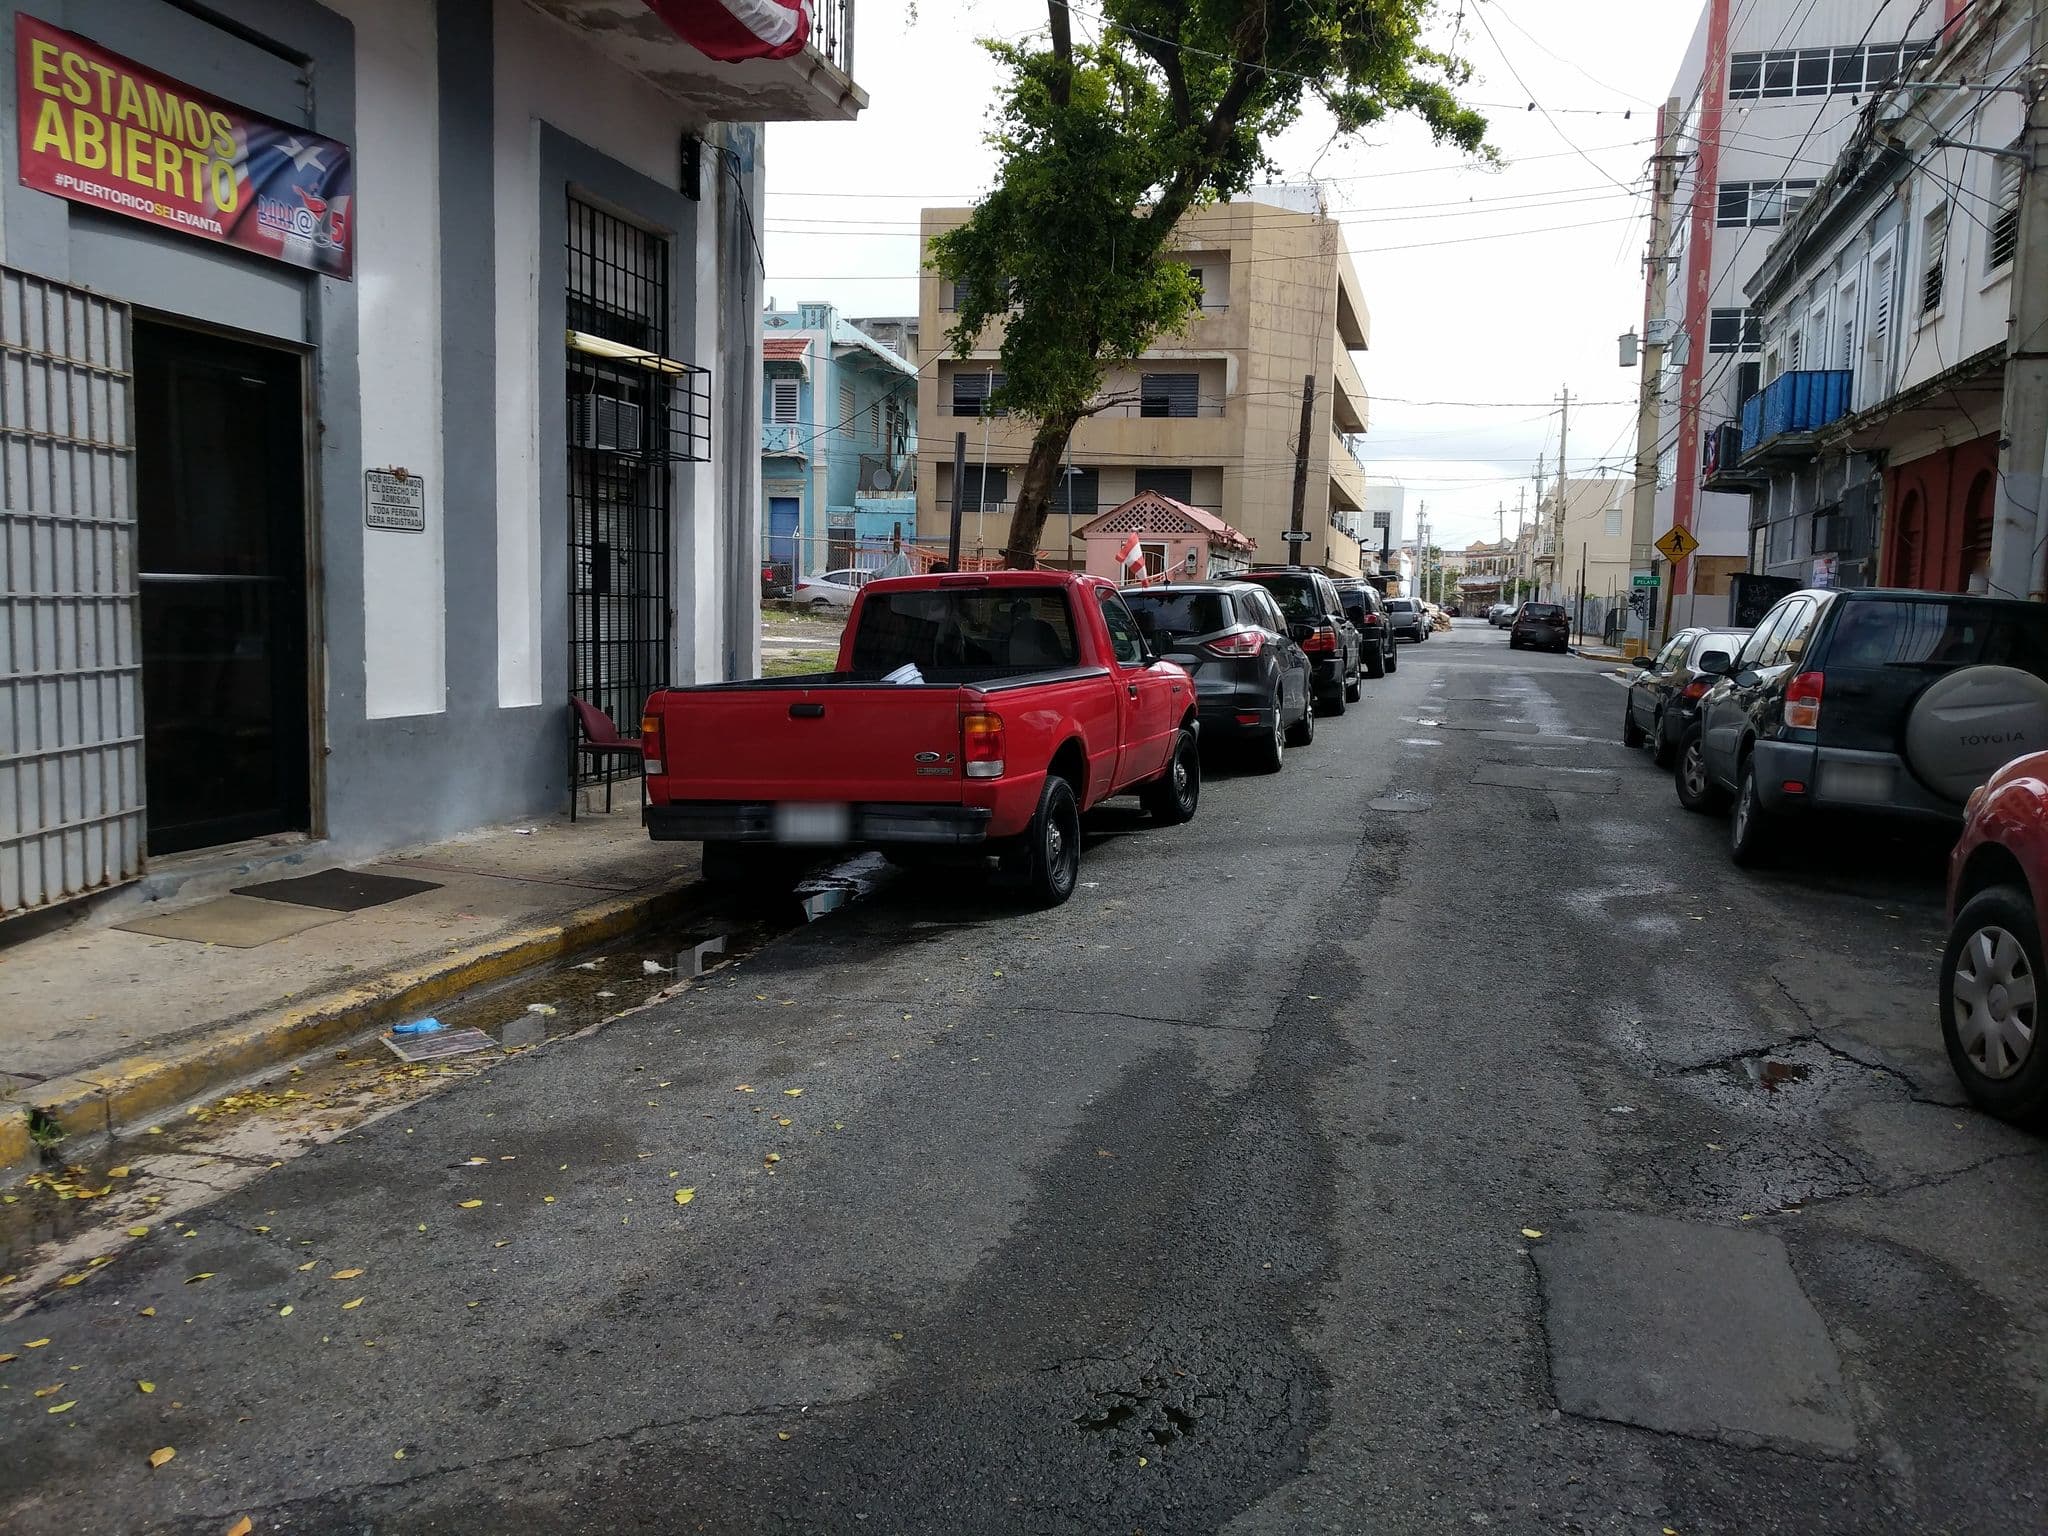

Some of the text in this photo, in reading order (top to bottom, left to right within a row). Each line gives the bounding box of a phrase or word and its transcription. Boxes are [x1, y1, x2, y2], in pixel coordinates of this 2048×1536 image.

[31, 38, 237, 159] ESTAMOS
[32, 98, 239, 214] ABIERTO
[55, 173, 223, 235] #PUERTORICOSELEVANTA
[368, 474, 382, 484] NOS
[372, 484, 418, 497] EL DERECHO DE
[381, 494, 411, 505] ADMISION
[373, 506, 418, 518] TODA PERSONA
[369, 515, 422, 527] SERA REGISTRADA
[1960, 731, 2025, 746] TOYOTA
